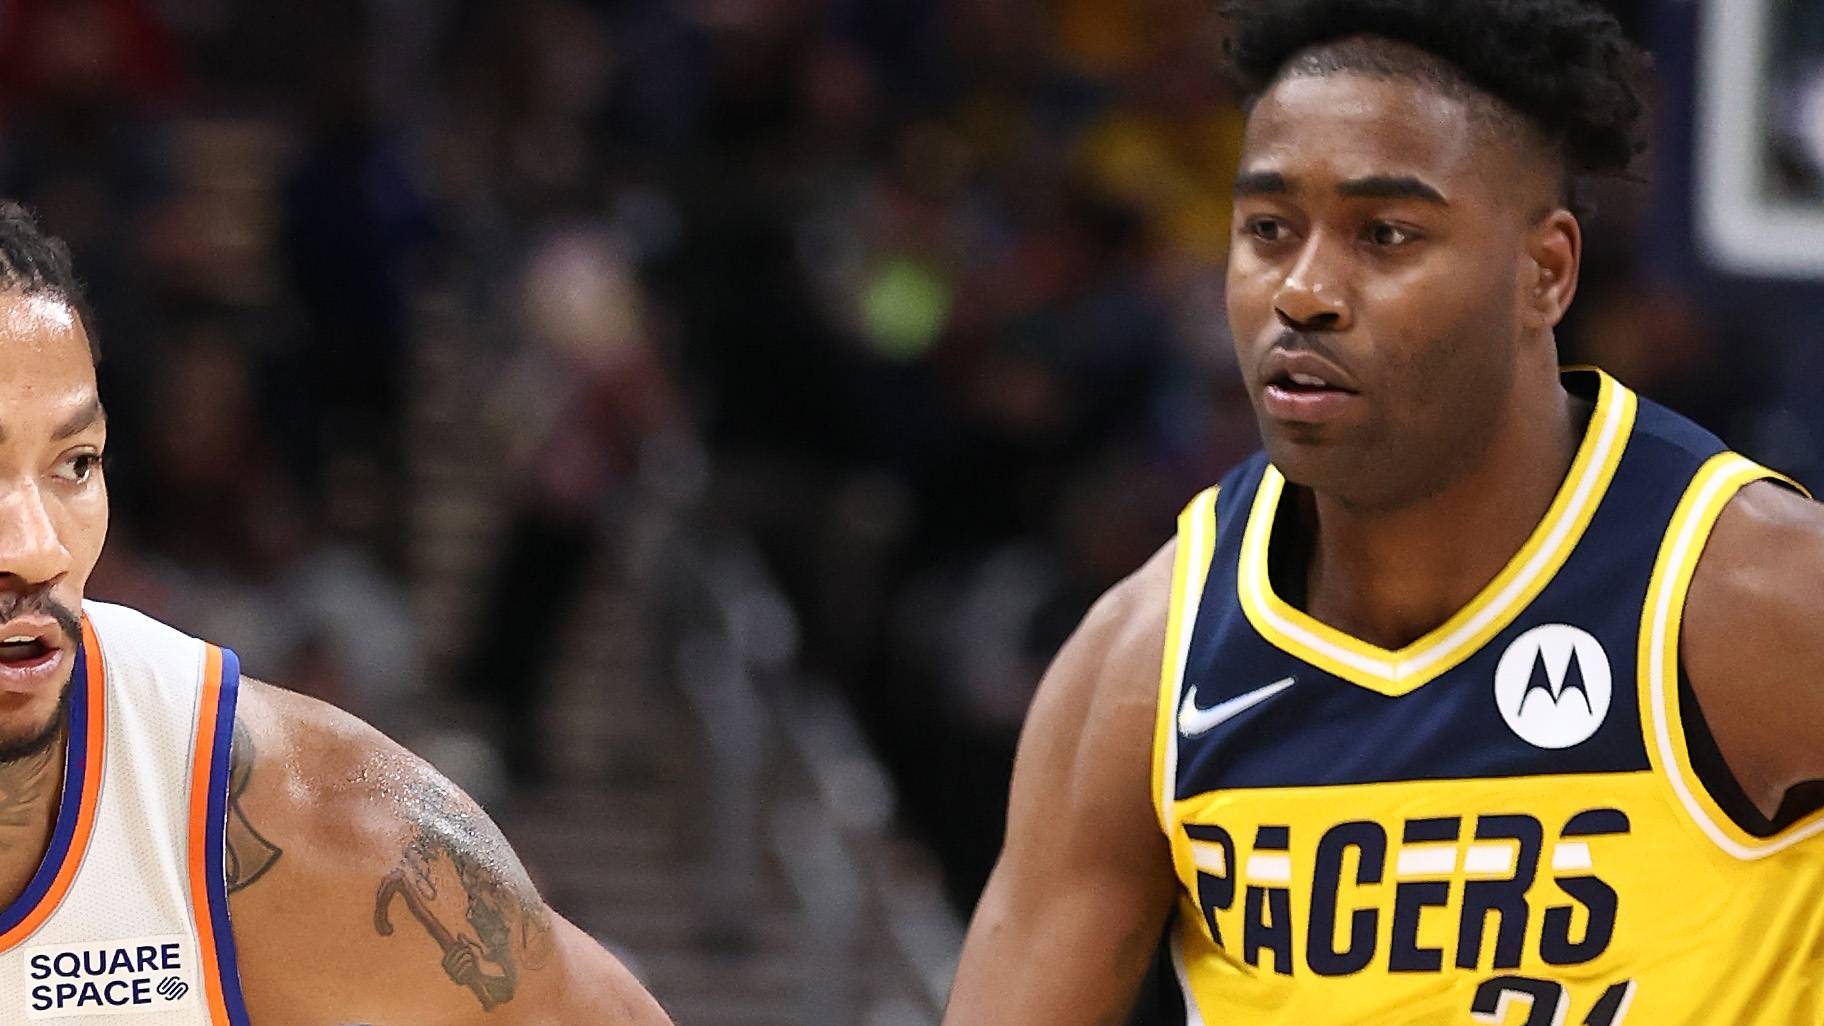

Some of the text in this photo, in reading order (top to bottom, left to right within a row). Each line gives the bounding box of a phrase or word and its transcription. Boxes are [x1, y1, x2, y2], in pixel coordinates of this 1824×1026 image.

[1183, 808, 1630, 977] PACERS
[30, 943, 181, 979] SQUARE
[32, 978, 152, 1011] SPACE
